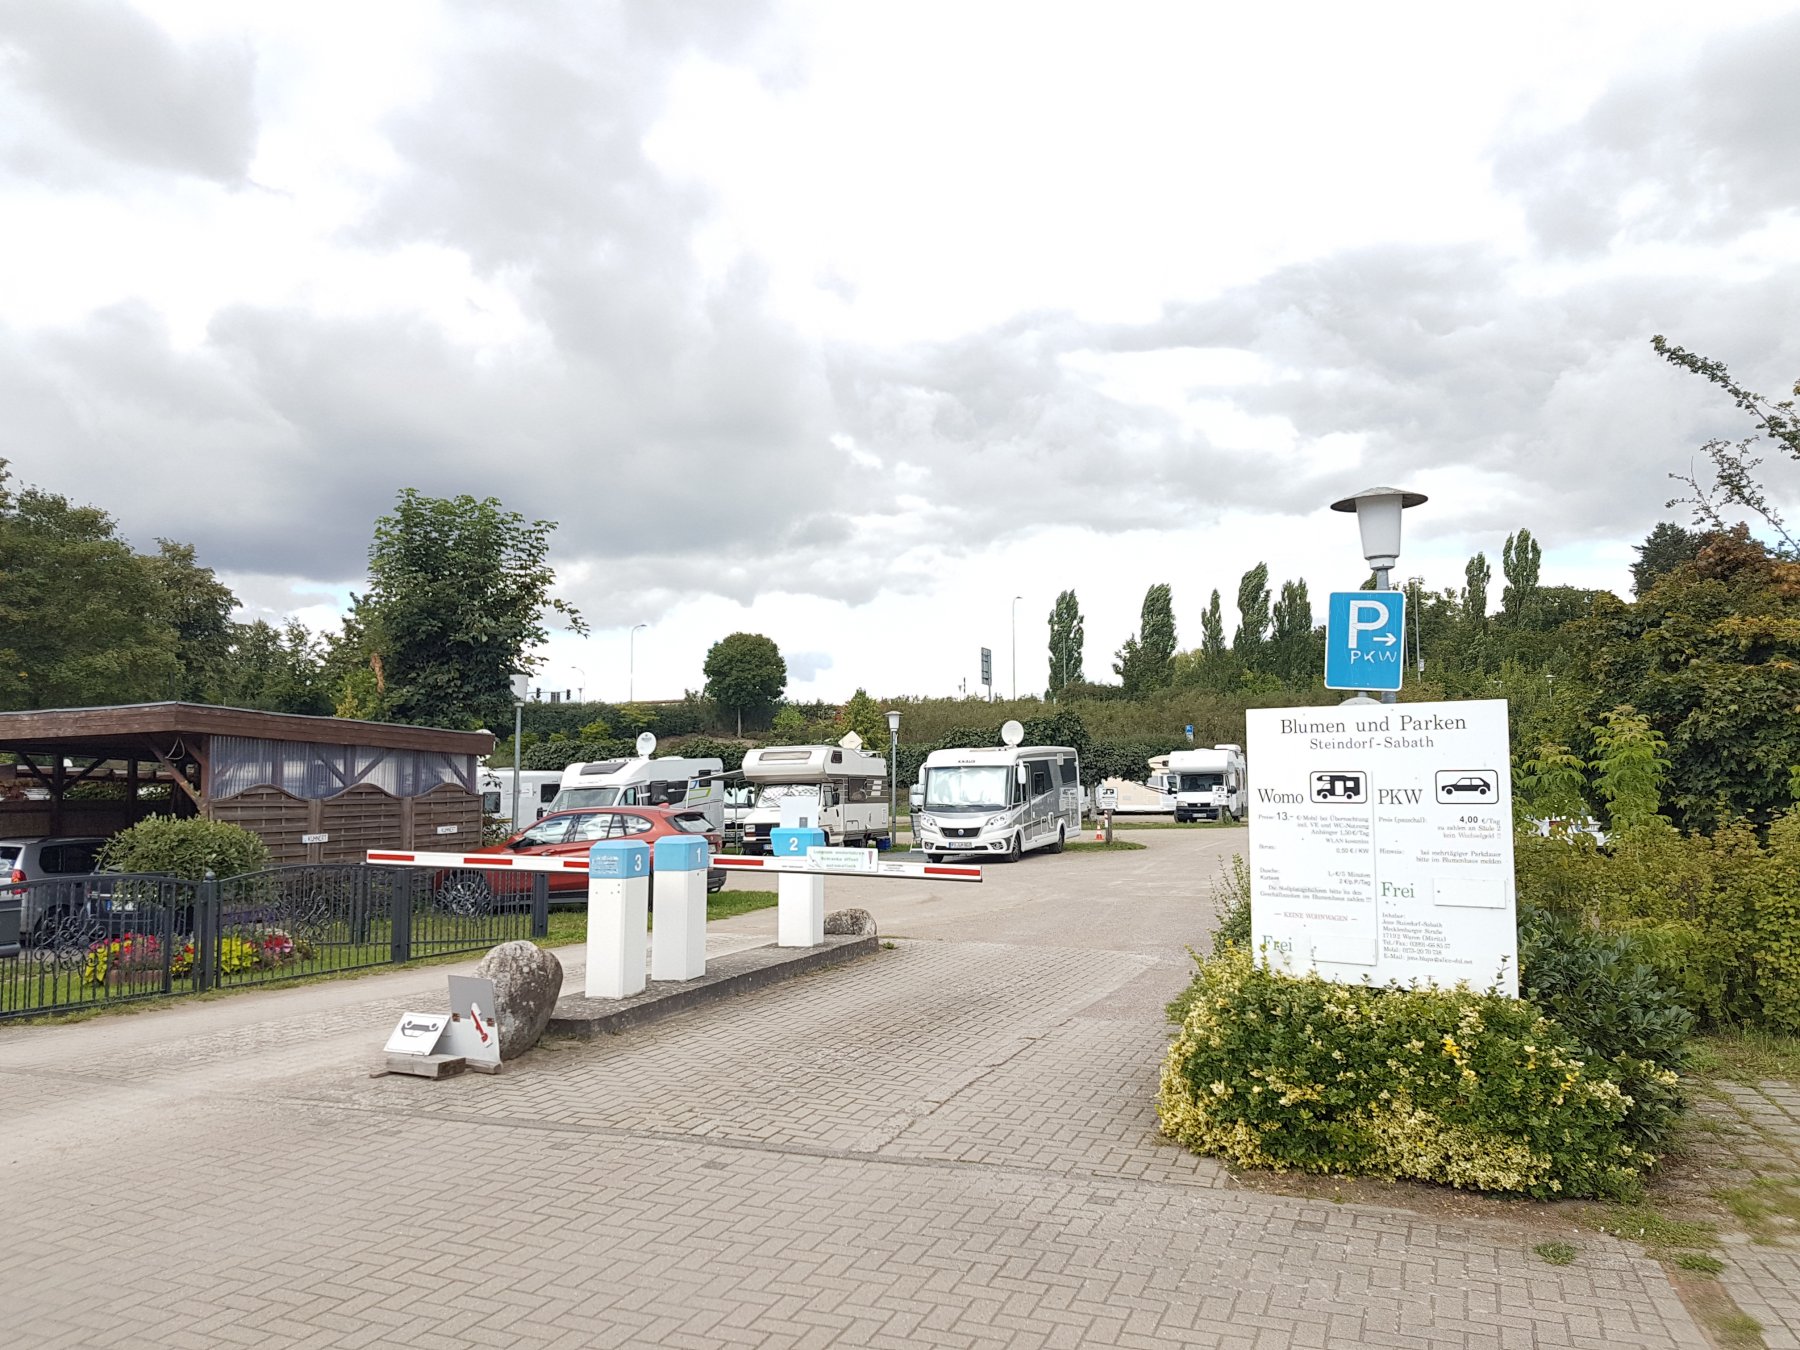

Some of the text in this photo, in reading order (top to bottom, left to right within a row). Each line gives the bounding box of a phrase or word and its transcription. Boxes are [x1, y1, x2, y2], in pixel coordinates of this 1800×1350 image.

[1348, 600, 1389, 648] P
[1351, 650, 1397, 664] PKW
[1281, 715, 1467, 735] Blumen und Parken
[1309, 737, 1434, 750] Steindorf-Sabath
[1258, 789, 1303, 804] Womo
[1378, 789, 1423, 804] PKW
[1459, 816, 1478, 824] 4,00
[790, 837, 798, 850] 2
[634, 854, 642, 871] 3
[696, 847, 701, 863] 1
[1381, 882, 1415, 898] Frei
[1262, 935, 1293, 951] Frei
